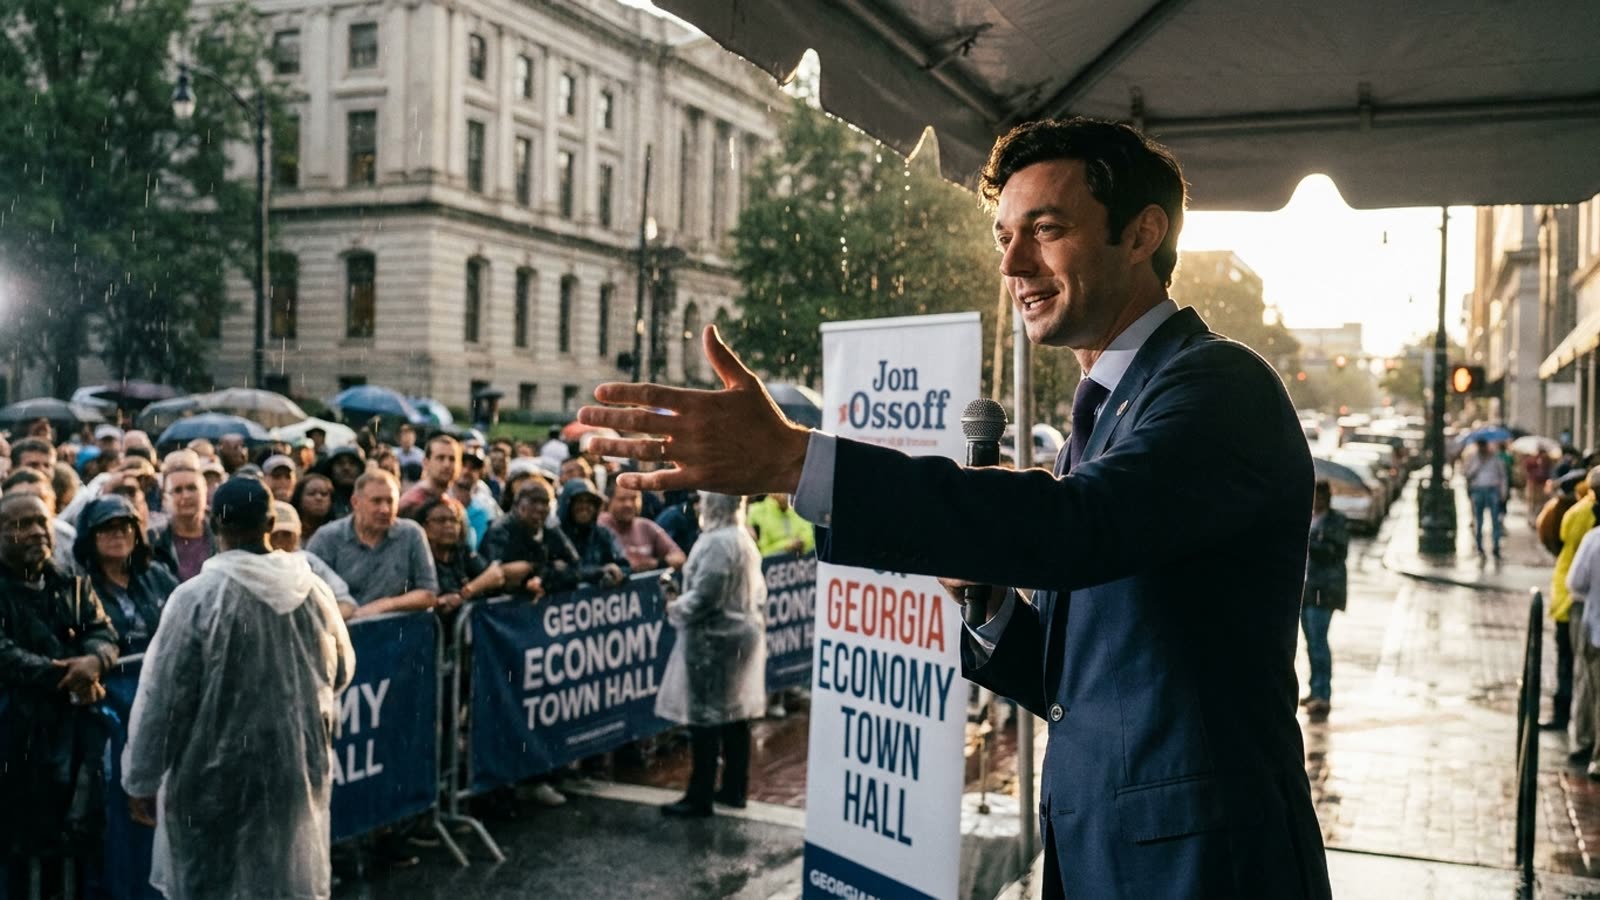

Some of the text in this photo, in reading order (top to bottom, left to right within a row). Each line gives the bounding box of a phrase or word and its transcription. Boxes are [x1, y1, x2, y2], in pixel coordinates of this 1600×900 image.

[849, 389, 950, 430] Ossoff
[873, 360, 918, 392] Jon
[543, 590, 641, 637] GEORGIA
[827, 577, 945, 652] GEORGIA
[522, 620, 663, 691] ECONOMY
[818, 639, 955, 721] ECONOMY
[523, 665, 659, 730] TOWN HALL
[841, 706, 920, 781] TOWN
[843, 770, 912, 846] HALL
[809, 868, 880, 900] GEORGIA
